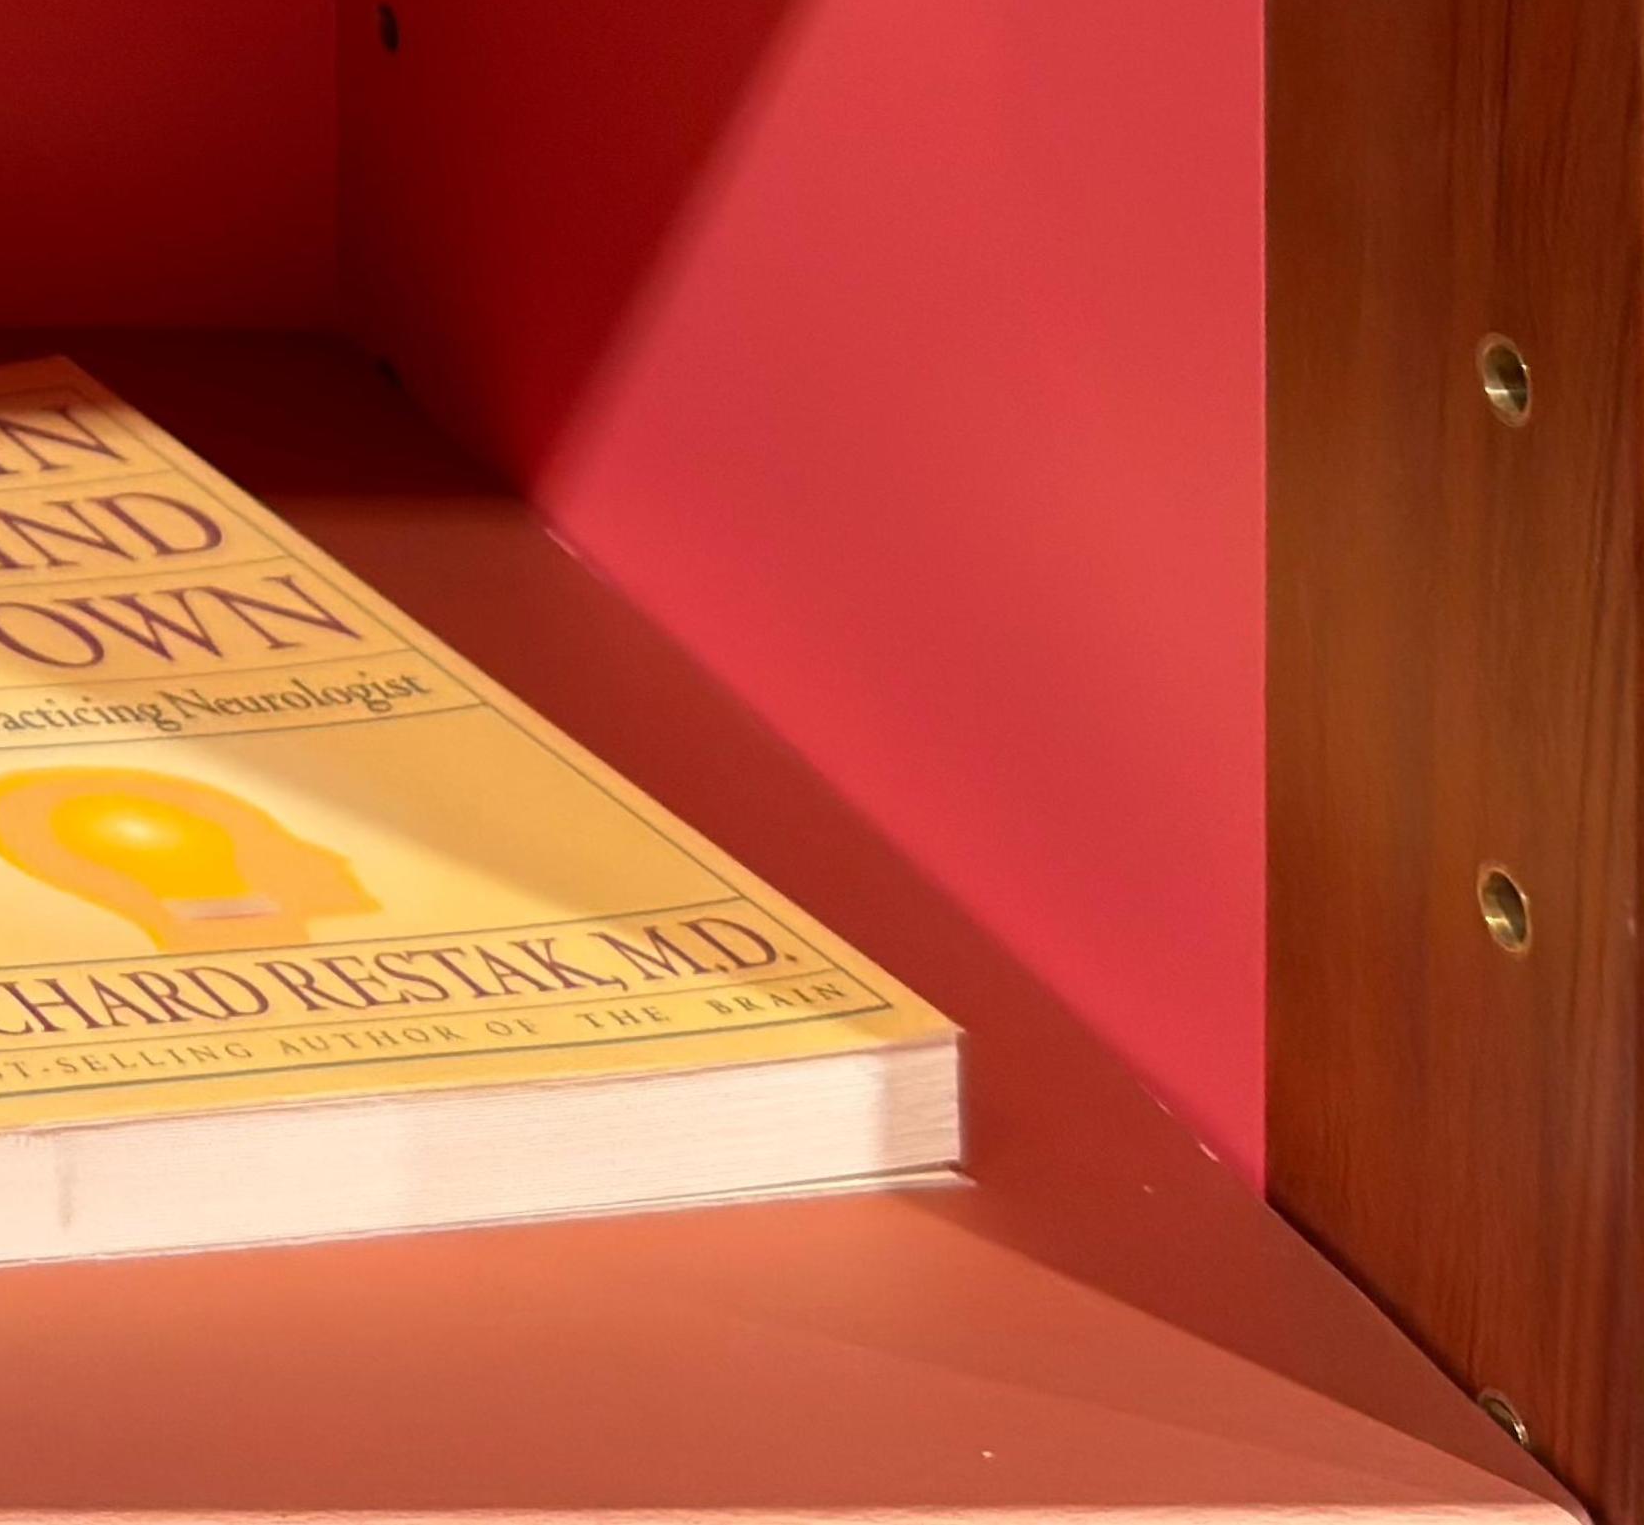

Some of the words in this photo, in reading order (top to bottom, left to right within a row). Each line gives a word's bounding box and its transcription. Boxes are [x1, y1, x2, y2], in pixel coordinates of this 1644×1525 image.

[171, 670, 431, 721] Neurologist
[266, 934, 627, 1014] RESTAK,
[588, 916, 797, 981] M.D.
[280, 1025, 464, 1056] AUTHOR
[485, 1018, 539, 1037] OF
[575, 1005, 670, 1030] THE
[706, 982, 847, 1016] BRAIN
